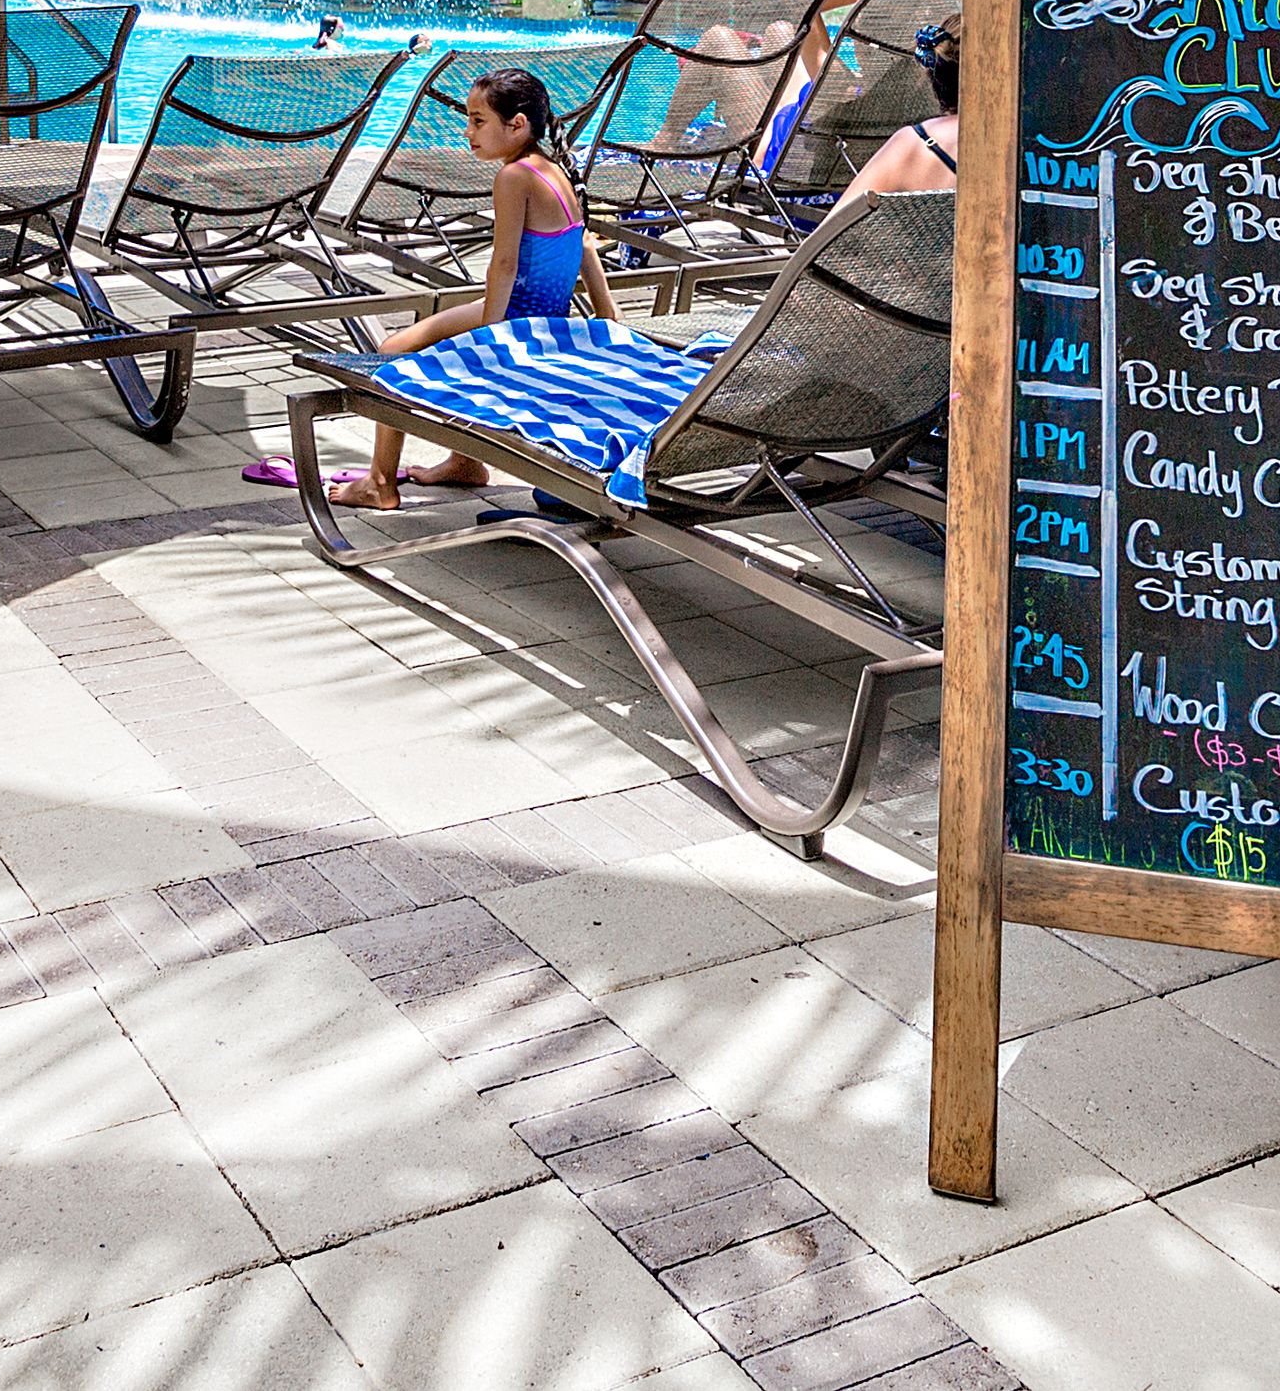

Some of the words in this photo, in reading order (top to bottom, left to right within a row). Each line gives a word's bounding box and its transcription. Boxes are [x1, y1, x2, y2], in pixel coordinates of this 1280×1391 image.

[1126, 150, 1210, 195] Sea
[1183, 197, 1216, 245] &
[1120, 258, 1210, 306] Sea
[1179, 303, 1212, 351] &
[1120, 360, 1264, 445] Pottery
[1123, 430, 1243, 517] Candy
[1134, 577, 1278, 651] String
[1013, 625, 1089, 689] 2:45
[1120, 650, 1227, 731] Wood
